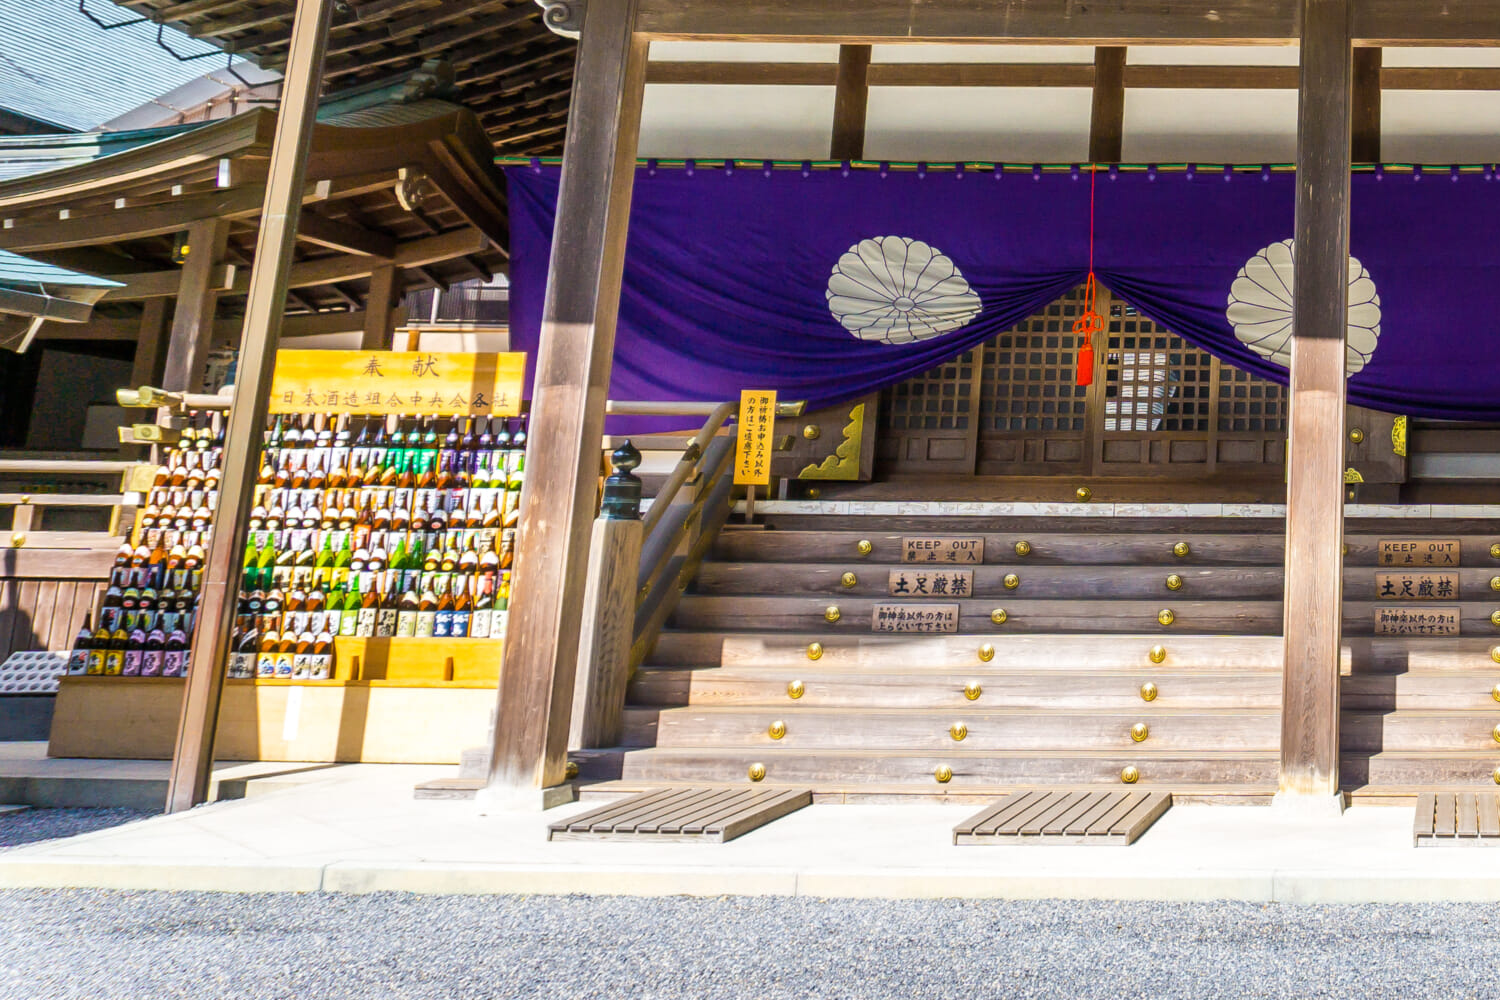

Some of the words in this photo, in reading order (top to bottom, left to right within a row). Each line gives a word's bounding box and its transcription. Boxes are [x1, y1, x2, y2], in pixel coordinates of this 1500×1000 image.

[362, 355, 440, 377] 奉献
[283, 388, 509, 408] 日本酒造組合中央会各社
[907, 540, 941, 549] KEEP
[952, 540, 978, 549] OUT
[1384, 543, 1417, 552] KEEP
[1428, 543, 1453, 552] OUT
[894, 575, 967, 595] 土足厳禁
[1381, 580, 1452, 597] 土足厳禁
